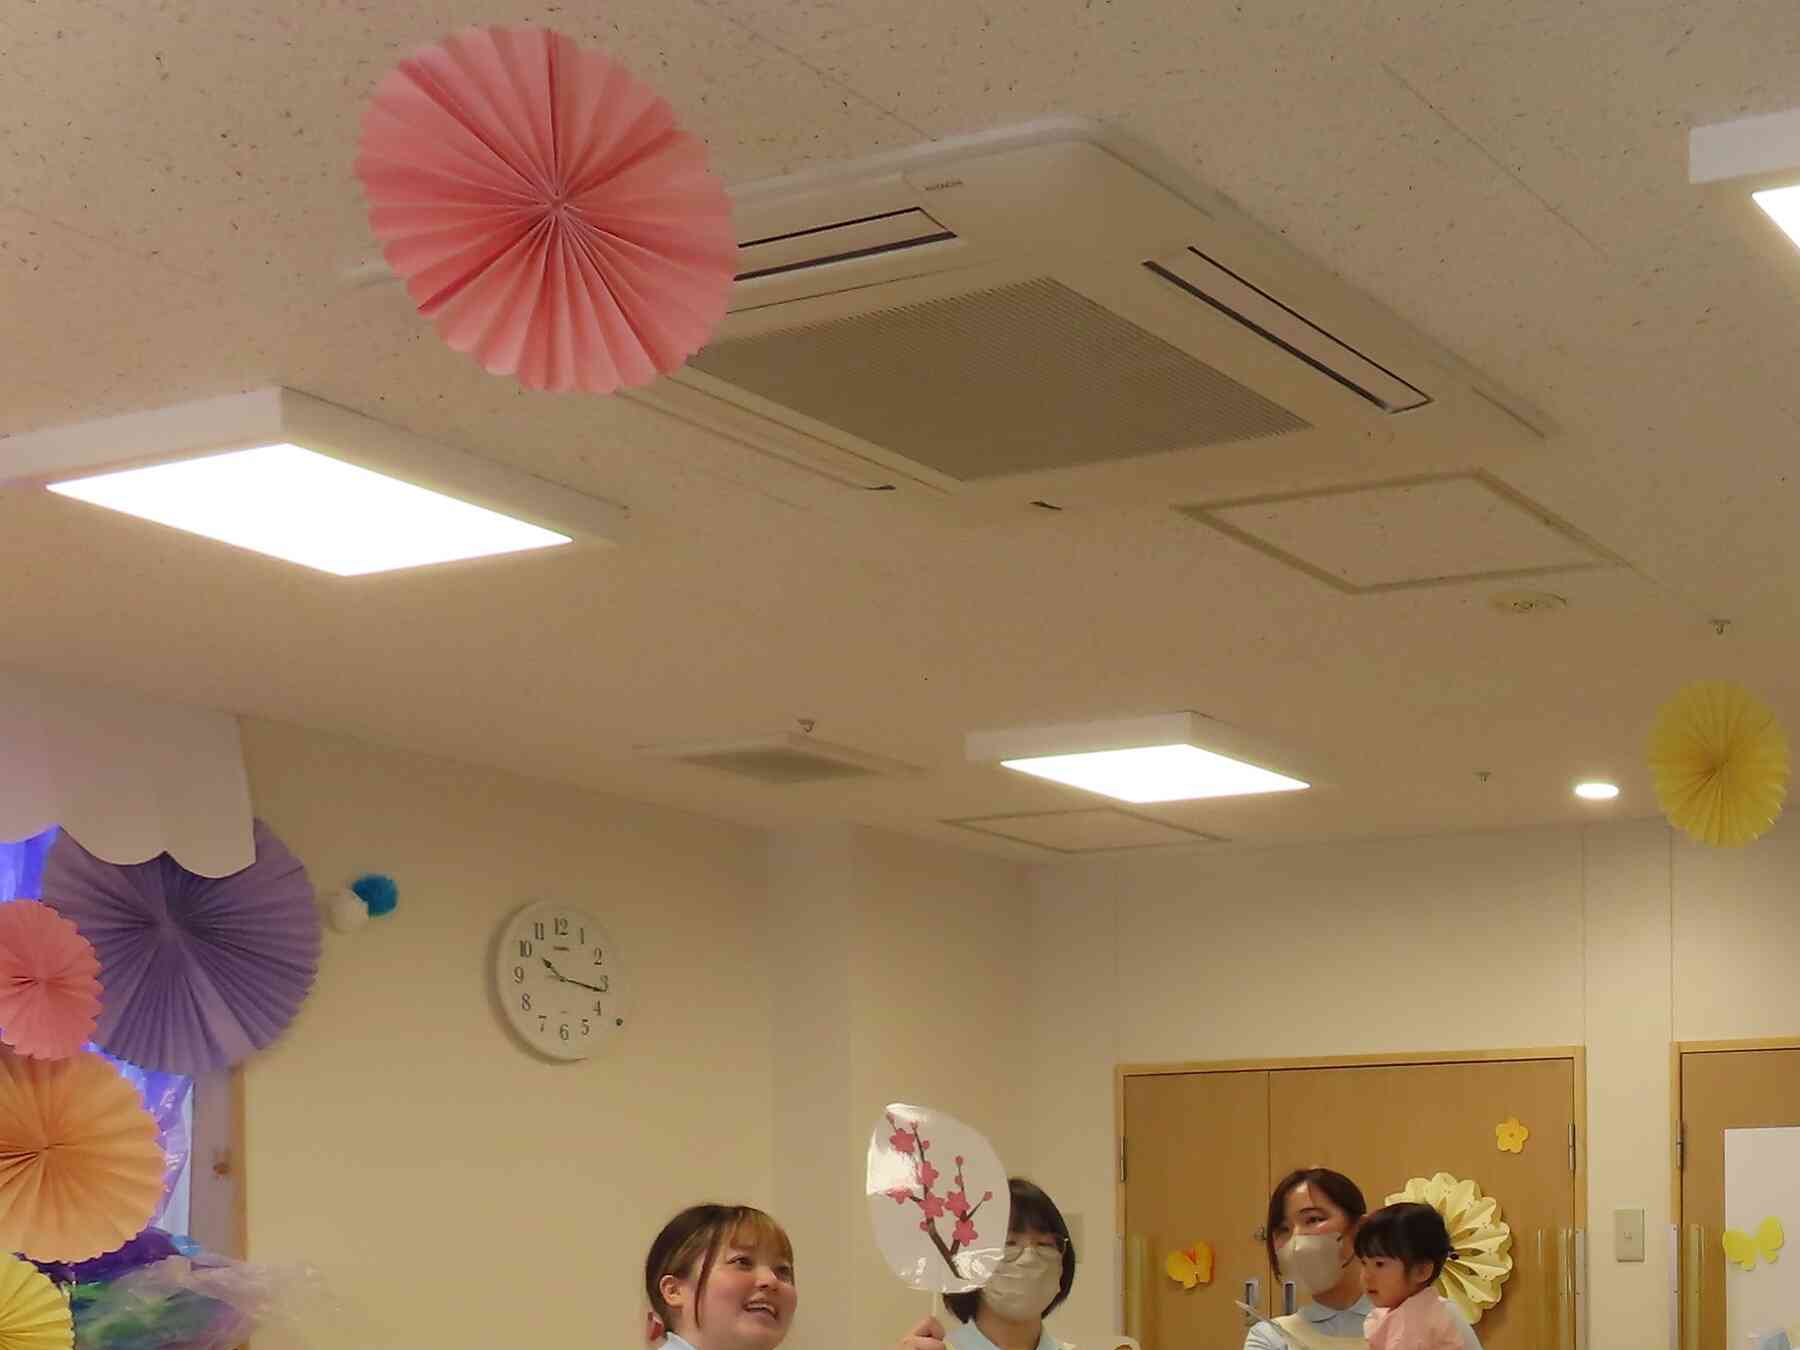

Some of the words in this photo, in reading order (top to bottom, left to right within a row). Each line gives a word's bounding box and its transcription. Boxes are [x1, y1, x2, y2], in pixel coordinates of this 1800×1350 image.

[534, 922, 544, 940] 11
[554, 917, 568, 935] 12
[579, 927, 585, 944] 1
[519, 940, 532, 957] 10
[593, 947, 602, 965] 2
[513, 966, 524, 984] 9
[599, 975, 609, 992] 3
[521, 993, 531, 1011] 8
[592, 1000, 602, 1016] 4
[537, 1014, 547, 1032] 7
[559, 1023, 569, 1040] 6
[581, 1018, 589, 1035] 5
